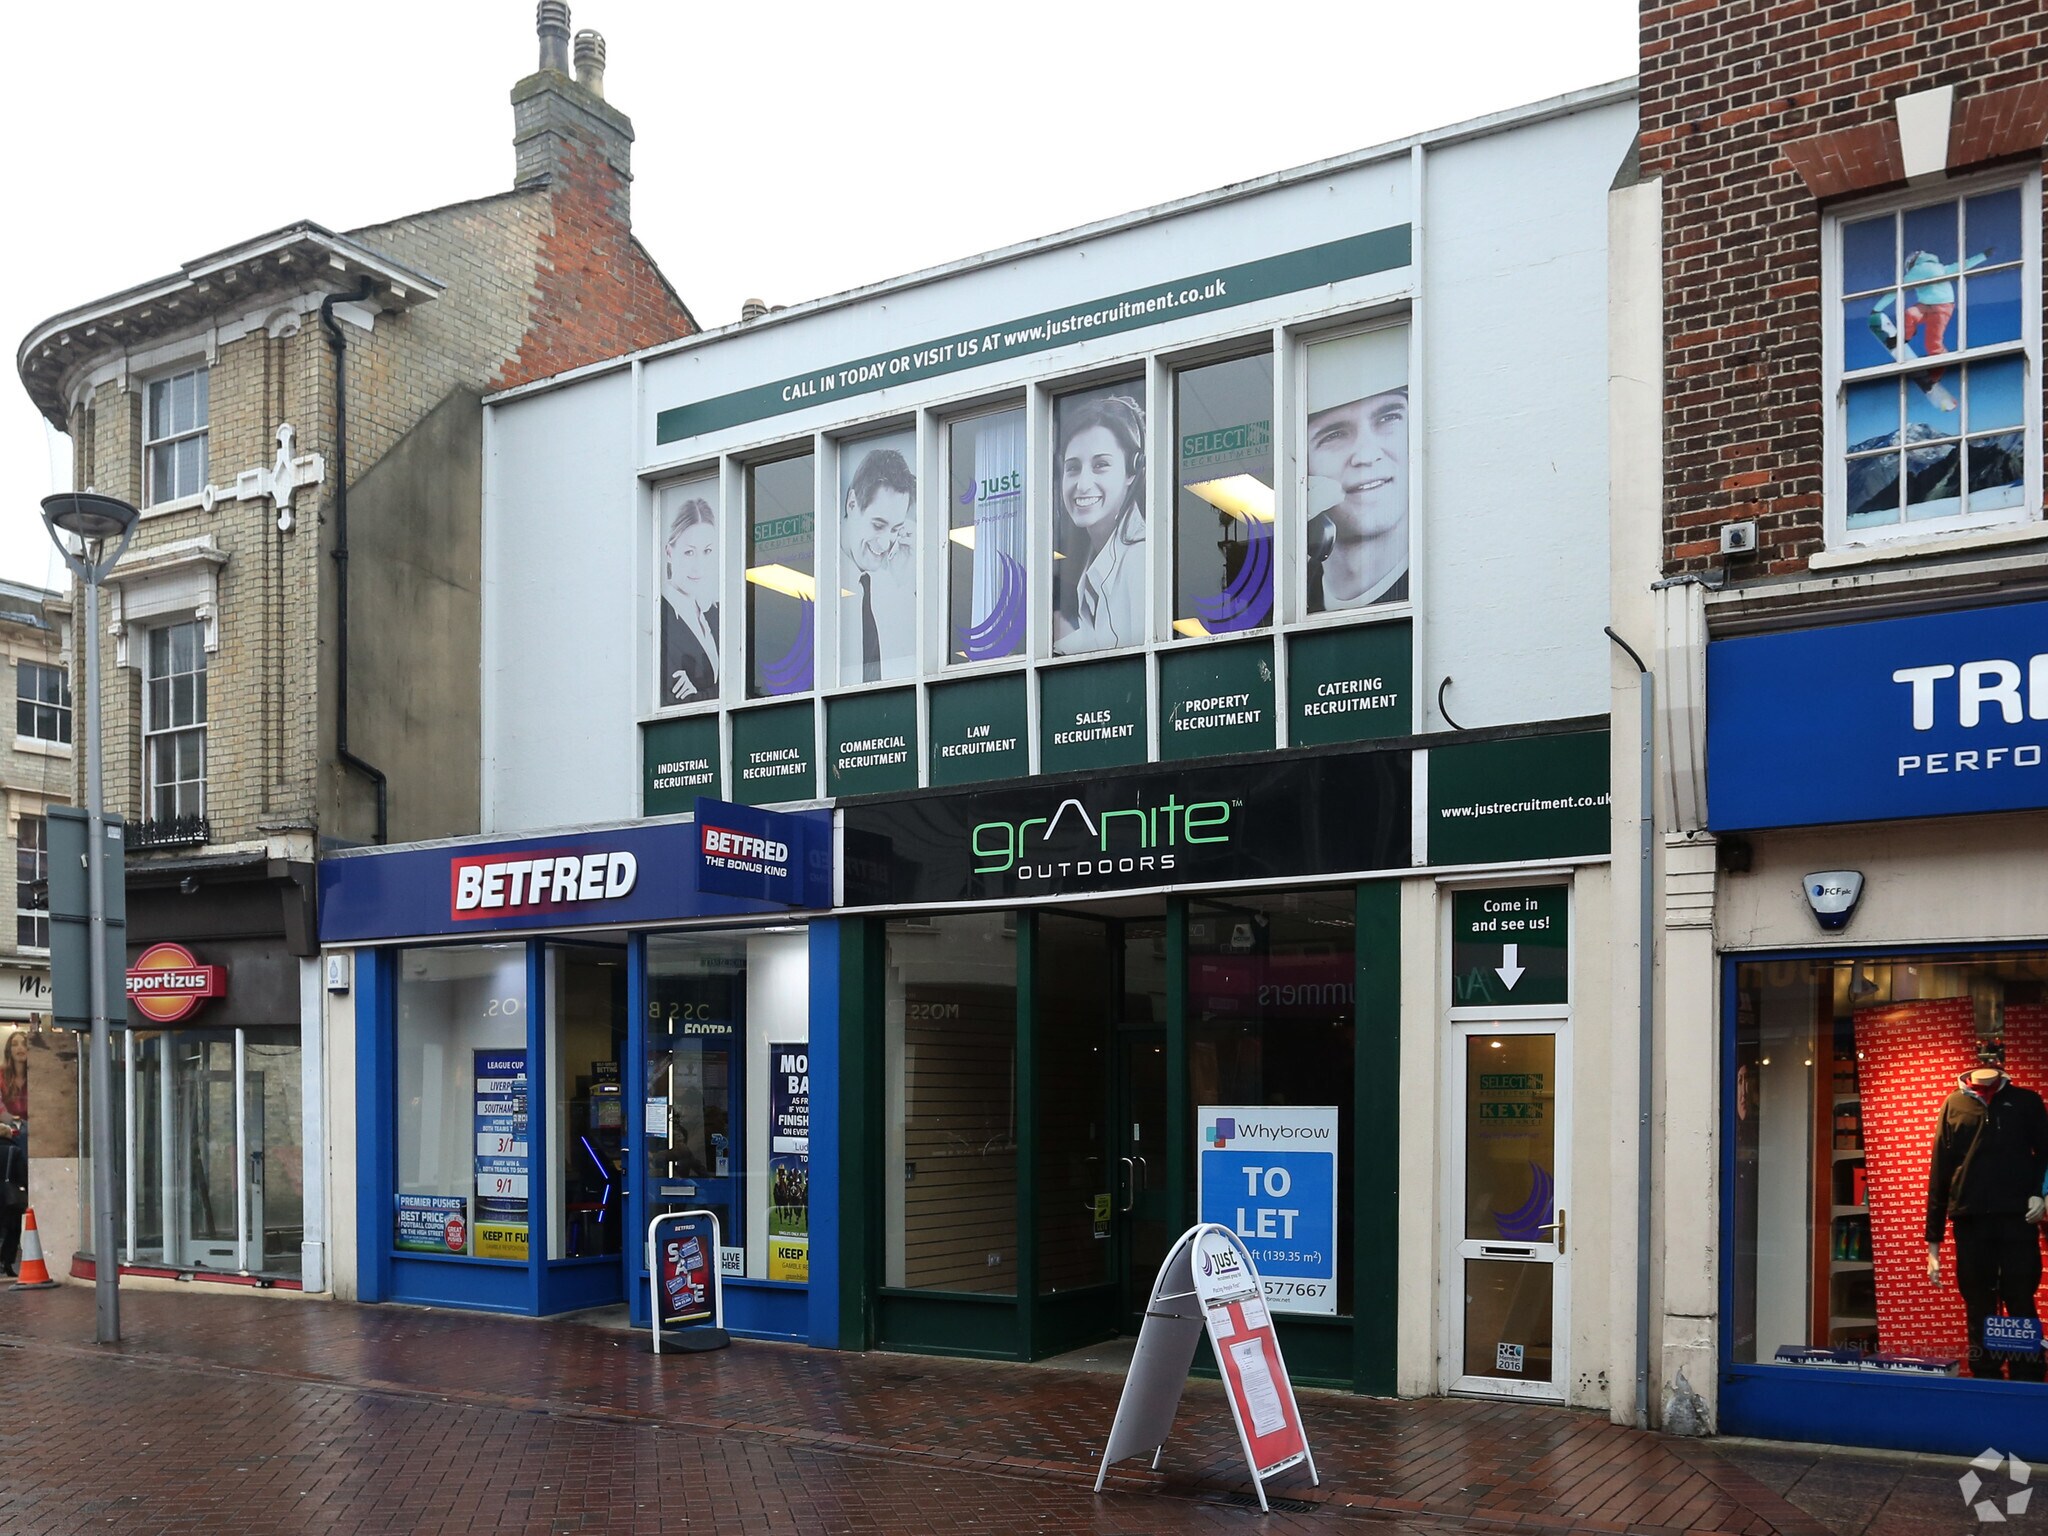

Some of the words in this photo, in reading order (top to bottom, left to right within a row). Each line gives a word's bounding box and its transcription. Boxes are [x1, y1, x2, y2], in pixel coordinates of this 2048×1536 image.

[782, 382, 816, 402] CALL
[820, 374, 835, 392] IN
[839, 361, 886, 387] TODAY
[889, 355, 910, 375] OR
[913, 344, 954, 369] VISIT
[957, 338, 978, 358] US
[981, 333, 1001, 353] AT
[1004, 278, 1227, 347] www.justrecruitment.co.uk
[1185, 429, 1244, 456] SELECT
[978, 470, 1021, 501] just
[755, 517, 799, 541] SELECT
[1317, 677, 1382, 697] CATERING
[1185, 693, 1249, 713] PROPERTY
[1304, 693, 1398, 717] RECRUITMENT
[1076, 710, 1111, 725] SALES
[1174, 710, 1261, 732] RECRUITMENT
[967, 724, 990, 738] LAW
[1054, 724, 1135, 745] RECRUITMENT
[840, 736, 906, 754] COMMERCIAL
[942, 738, 1017, 758] RECRUITMENT
[750, 748, 800, 764] TECHNICAL
[838, 751, 908, 770] RECRUITMENT
[1898, 745, 2041, 777] PERFO
[658, 758, 709, 775] INDUSTRIAL
[743, 762, 808, 780] RECRUITMENT
[653, 773, 714, 789] RECRUITMENT
[1441, 792, 1612, 818] www.justrecruitment.co.uk
[705, 829, 788, 863] BETFRED
[705, 856, 724, 868] THE
[727, 858, 762, 873] BONUS
[763, 863, 787, 878] KING
[1018, 854, 1175, 880] OUTDOORS
[455, 851, 638, 910] BETFRED
[1825, 887, 1841, 895] FCF
[1484, 900, 1521, 912] Come
[1525, 898, 1538, 910] in
[1472, 918, 1497, 932] and
[1501, 920, 1525, 931] see
[1529, 916, 1550, 929] us!
[126, 971, 205, 992] sportizus
[487, 1061, 510, 1069] LEAGUE
[511, 1061, 524, 1069] CUP
[1482, 1076, 1525, 1088] SELECT
[791, 1097, 800, 1105] AS
[1482, 1104, 1525, 1117] KEY
[1238, 1124, 1330, 1141] Whybrow
[498, 1138, 513, 1152] 3/1
[497, 1178, 512, 1193] 9/1
[1242, 1166, 1291, 1198] TO
[400, 1197, 431, 1206] PREMIER
[432, 1198, 460, 1208] PUSHES
[400, 1211, 420, 1221] BEST
[421, 1212, 444, 1223] PRICE
[400, 1221, 424, 1229] FOOTBALL
[1236, 1207, 1299, 1239] LET
[675, 1224, 695, 1232] BETFRED
[483, 1231, 502, 1242] KEEP
[505, 1232, 512, 1242] IT
[722, 1253, 740, 1262] LIVE
[779, 1247, 803, 1260] KEEP
[1212, 1245, 1237, 1275] just
[1251, 1249, 1260, 1260] ft
[1263, 1249, 1300, 1262] (139.35
[722, 1262, 740, 1270] HERE
[1264, 1282, 1326, 1297] 577667
[1987, 1318, 2020, 1328] CLICK
[2023, 1319, 2033, 1329] &
[1987, 1328, 2036, 1339] COLLECT
[1499, 1360, 1520, 1370] 2016
